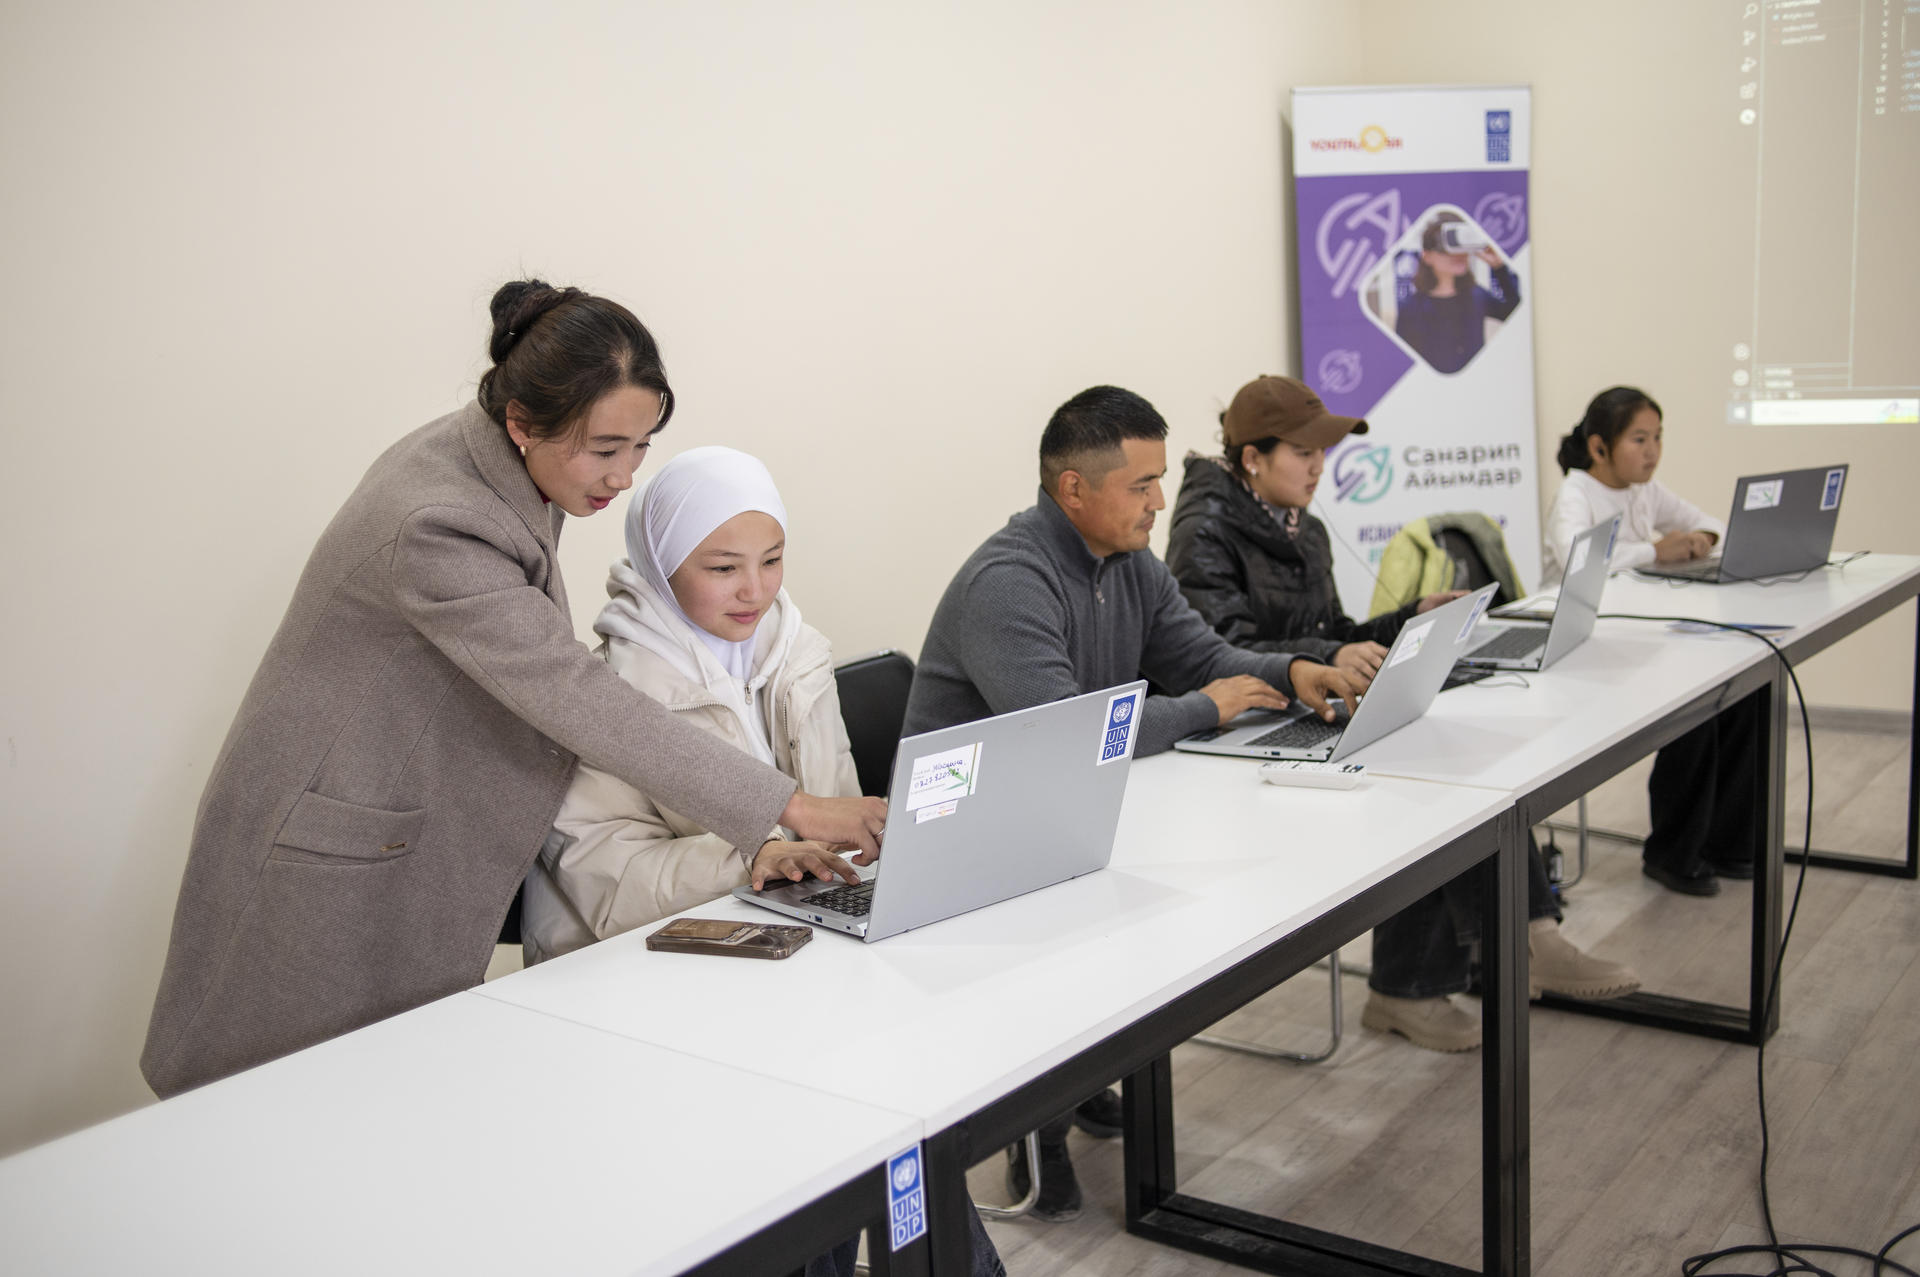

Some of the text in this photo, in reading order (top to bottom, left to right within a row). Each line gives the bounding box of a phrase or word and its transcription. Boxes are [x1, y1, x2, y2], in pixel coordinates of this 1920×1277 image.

[1403, 443, 1520, 466] Санарип
[1404, 467, 1521, 489] Айымдар
[1108, 727, 1128, 743] UN
[1105, 743, 1124, 758] DP
[895, 1193, 921, 1220] UN
[896, 1215, 920, 1244] DP
